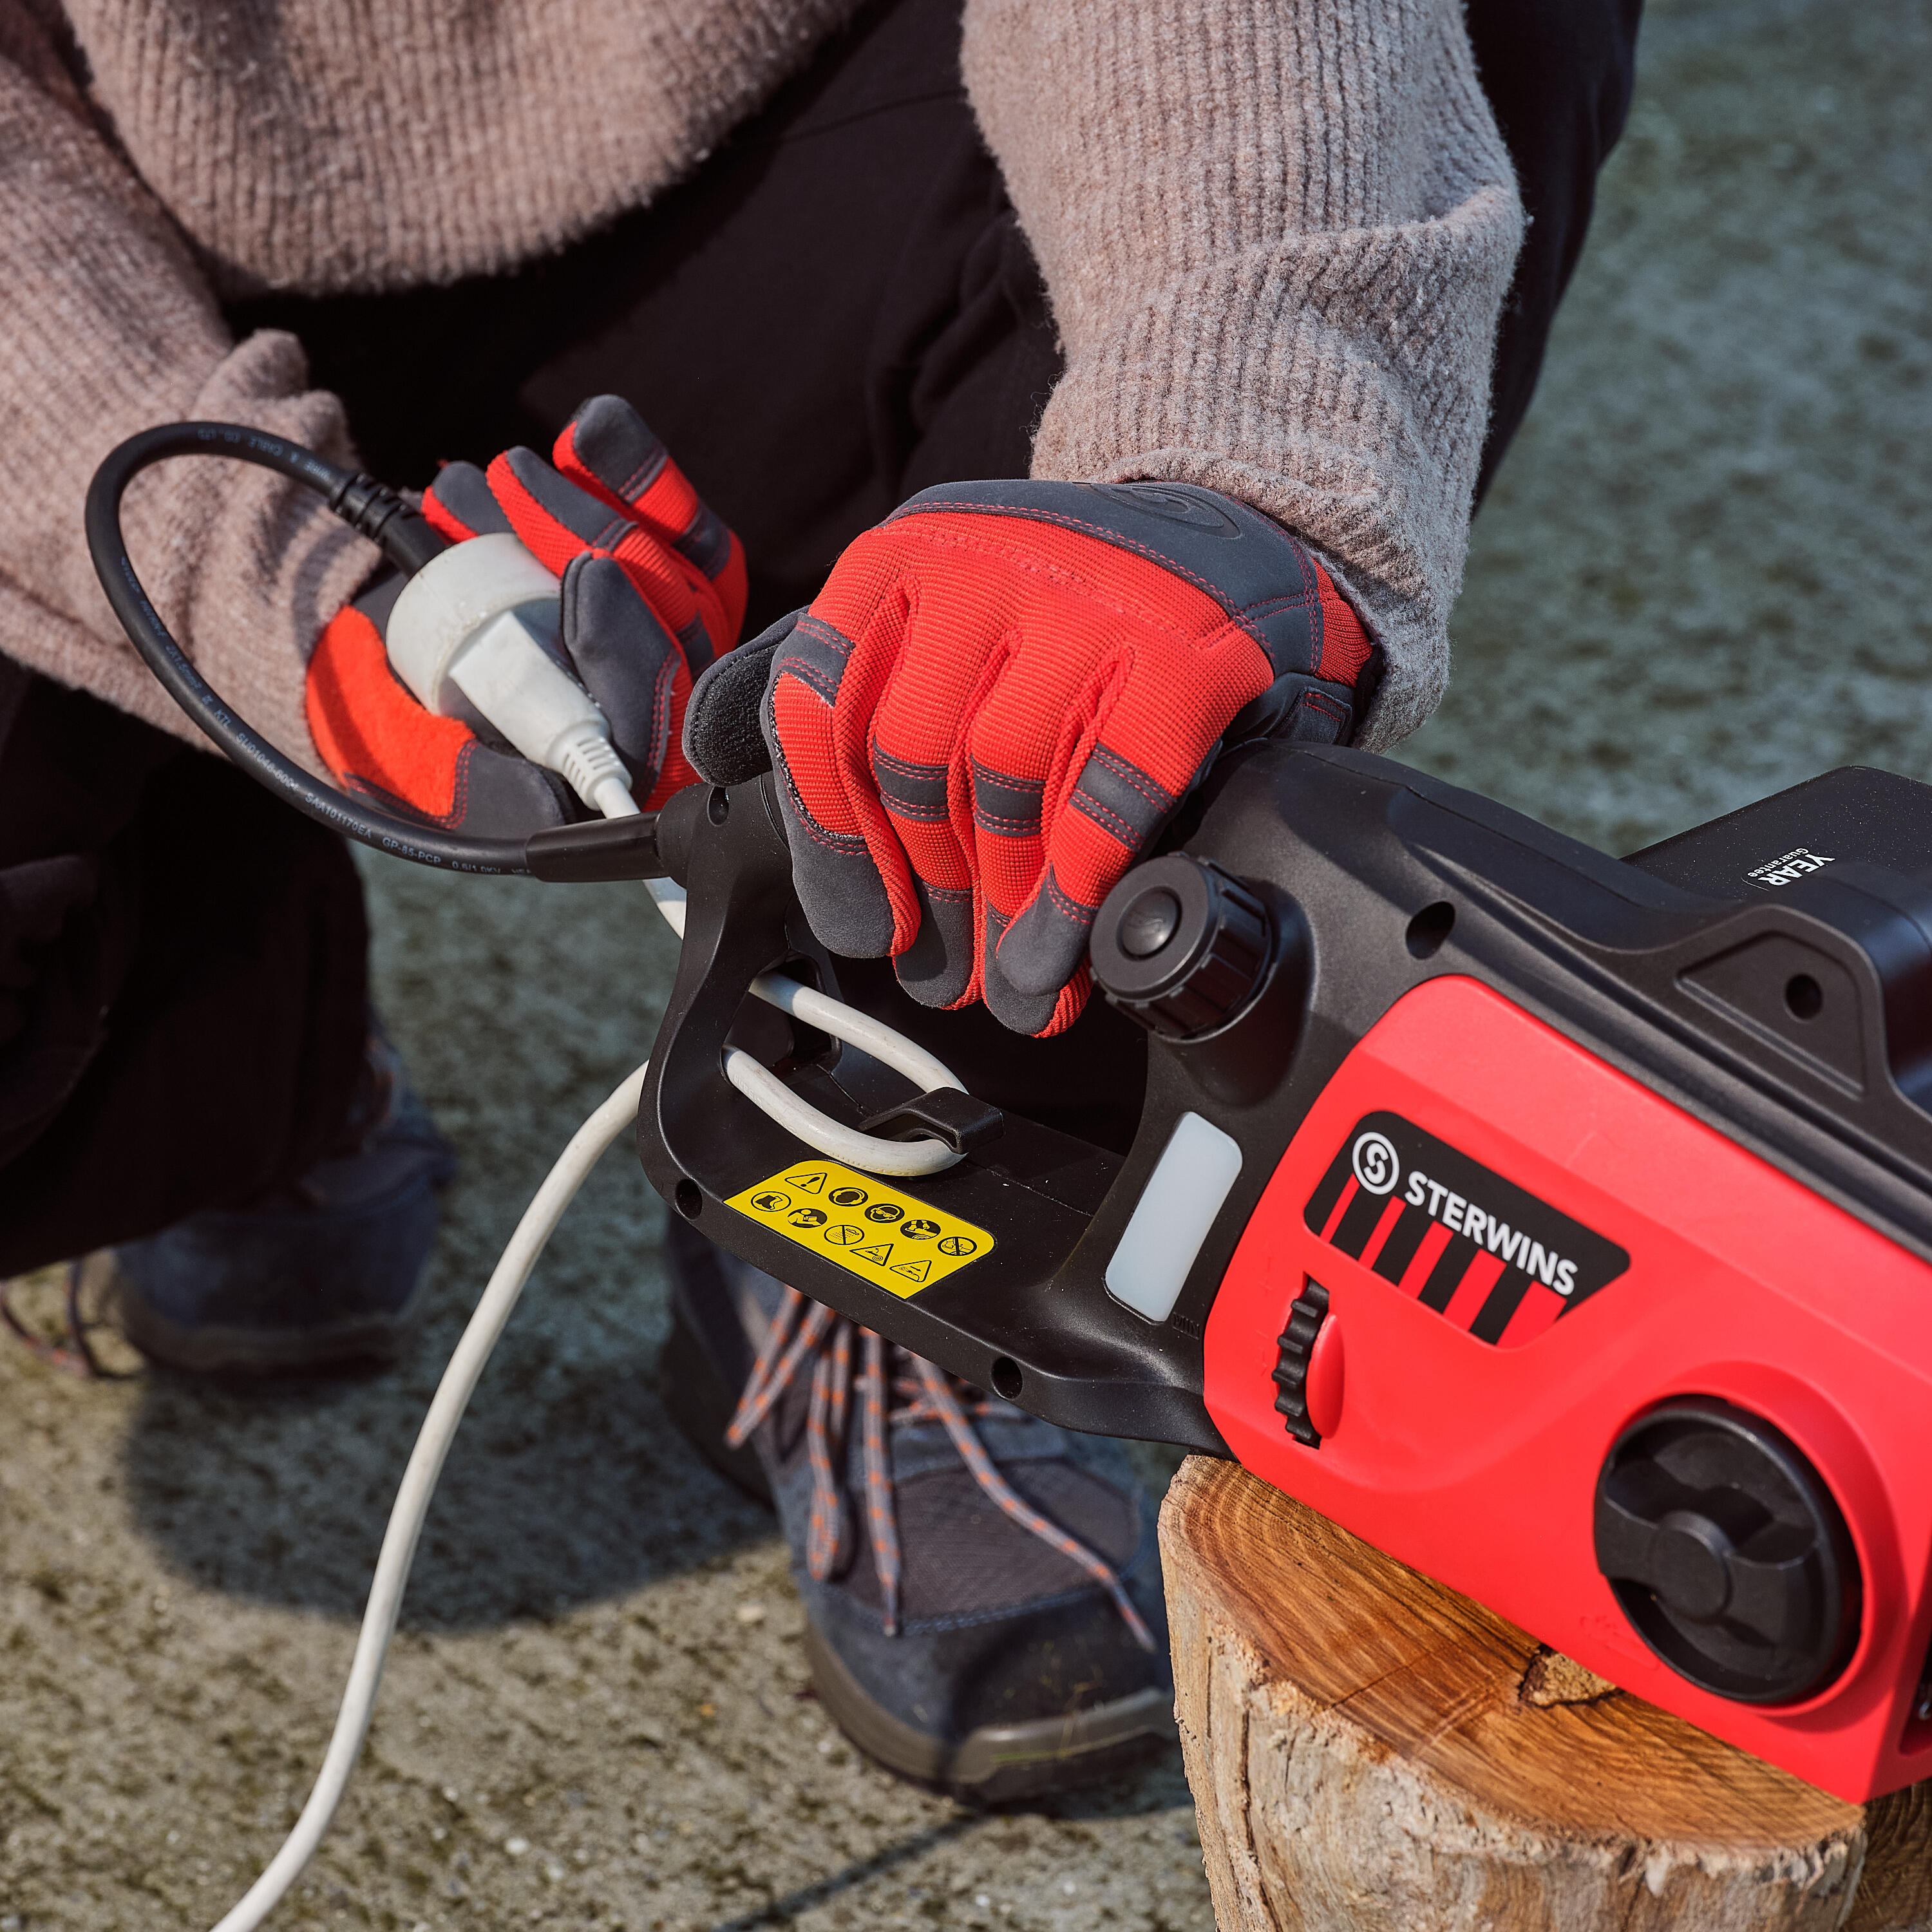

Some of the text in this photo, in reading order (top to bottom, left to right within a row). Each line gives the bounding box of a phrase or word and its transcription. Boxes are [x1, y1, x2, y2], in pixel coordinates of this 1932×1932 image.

[1747, 848, 1809, 878] Guarantee
[1757, 854, 1836, 886] YEAR
[1404, 1170, 1578, 1296] STERWINS
